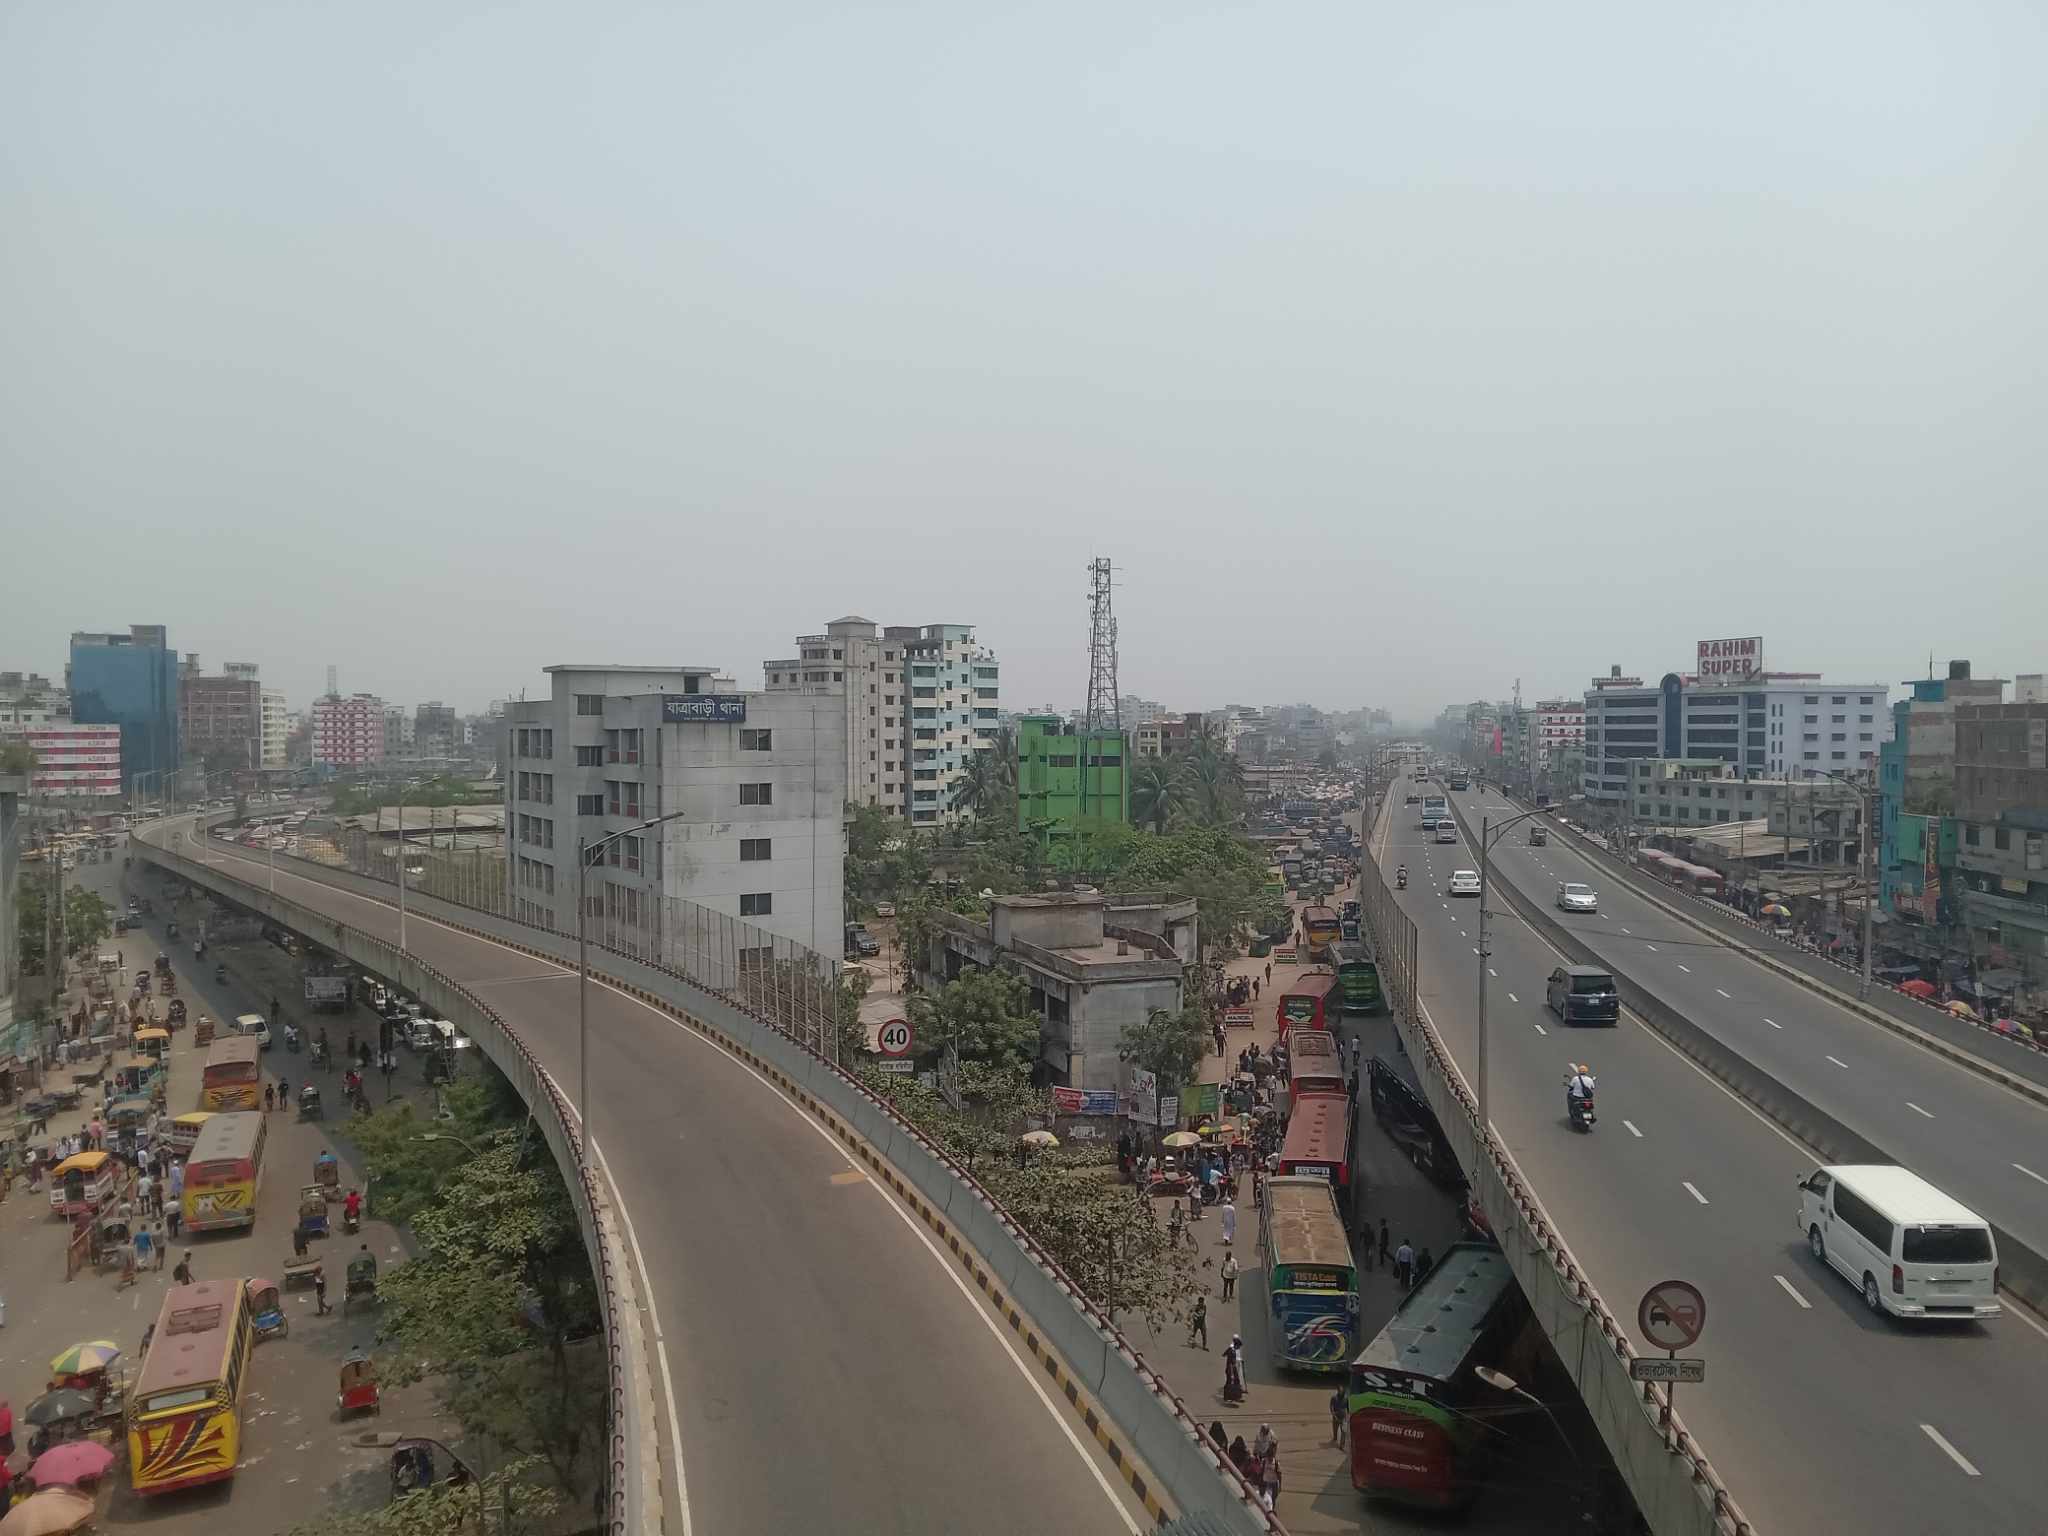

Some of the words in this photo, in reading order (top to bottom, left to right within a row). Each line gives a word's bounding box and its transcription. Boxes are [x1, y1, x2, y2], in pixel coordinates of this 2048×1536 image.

[1700, 640, 1755, 657] RAHIM
[1701, 659, 1752, 675] SUPER
[667, 699, 715, 717] যাত্রাবাড়ী
[720, 702, 744, 715] থানা
[884, 1028, 907, 1045] 40
